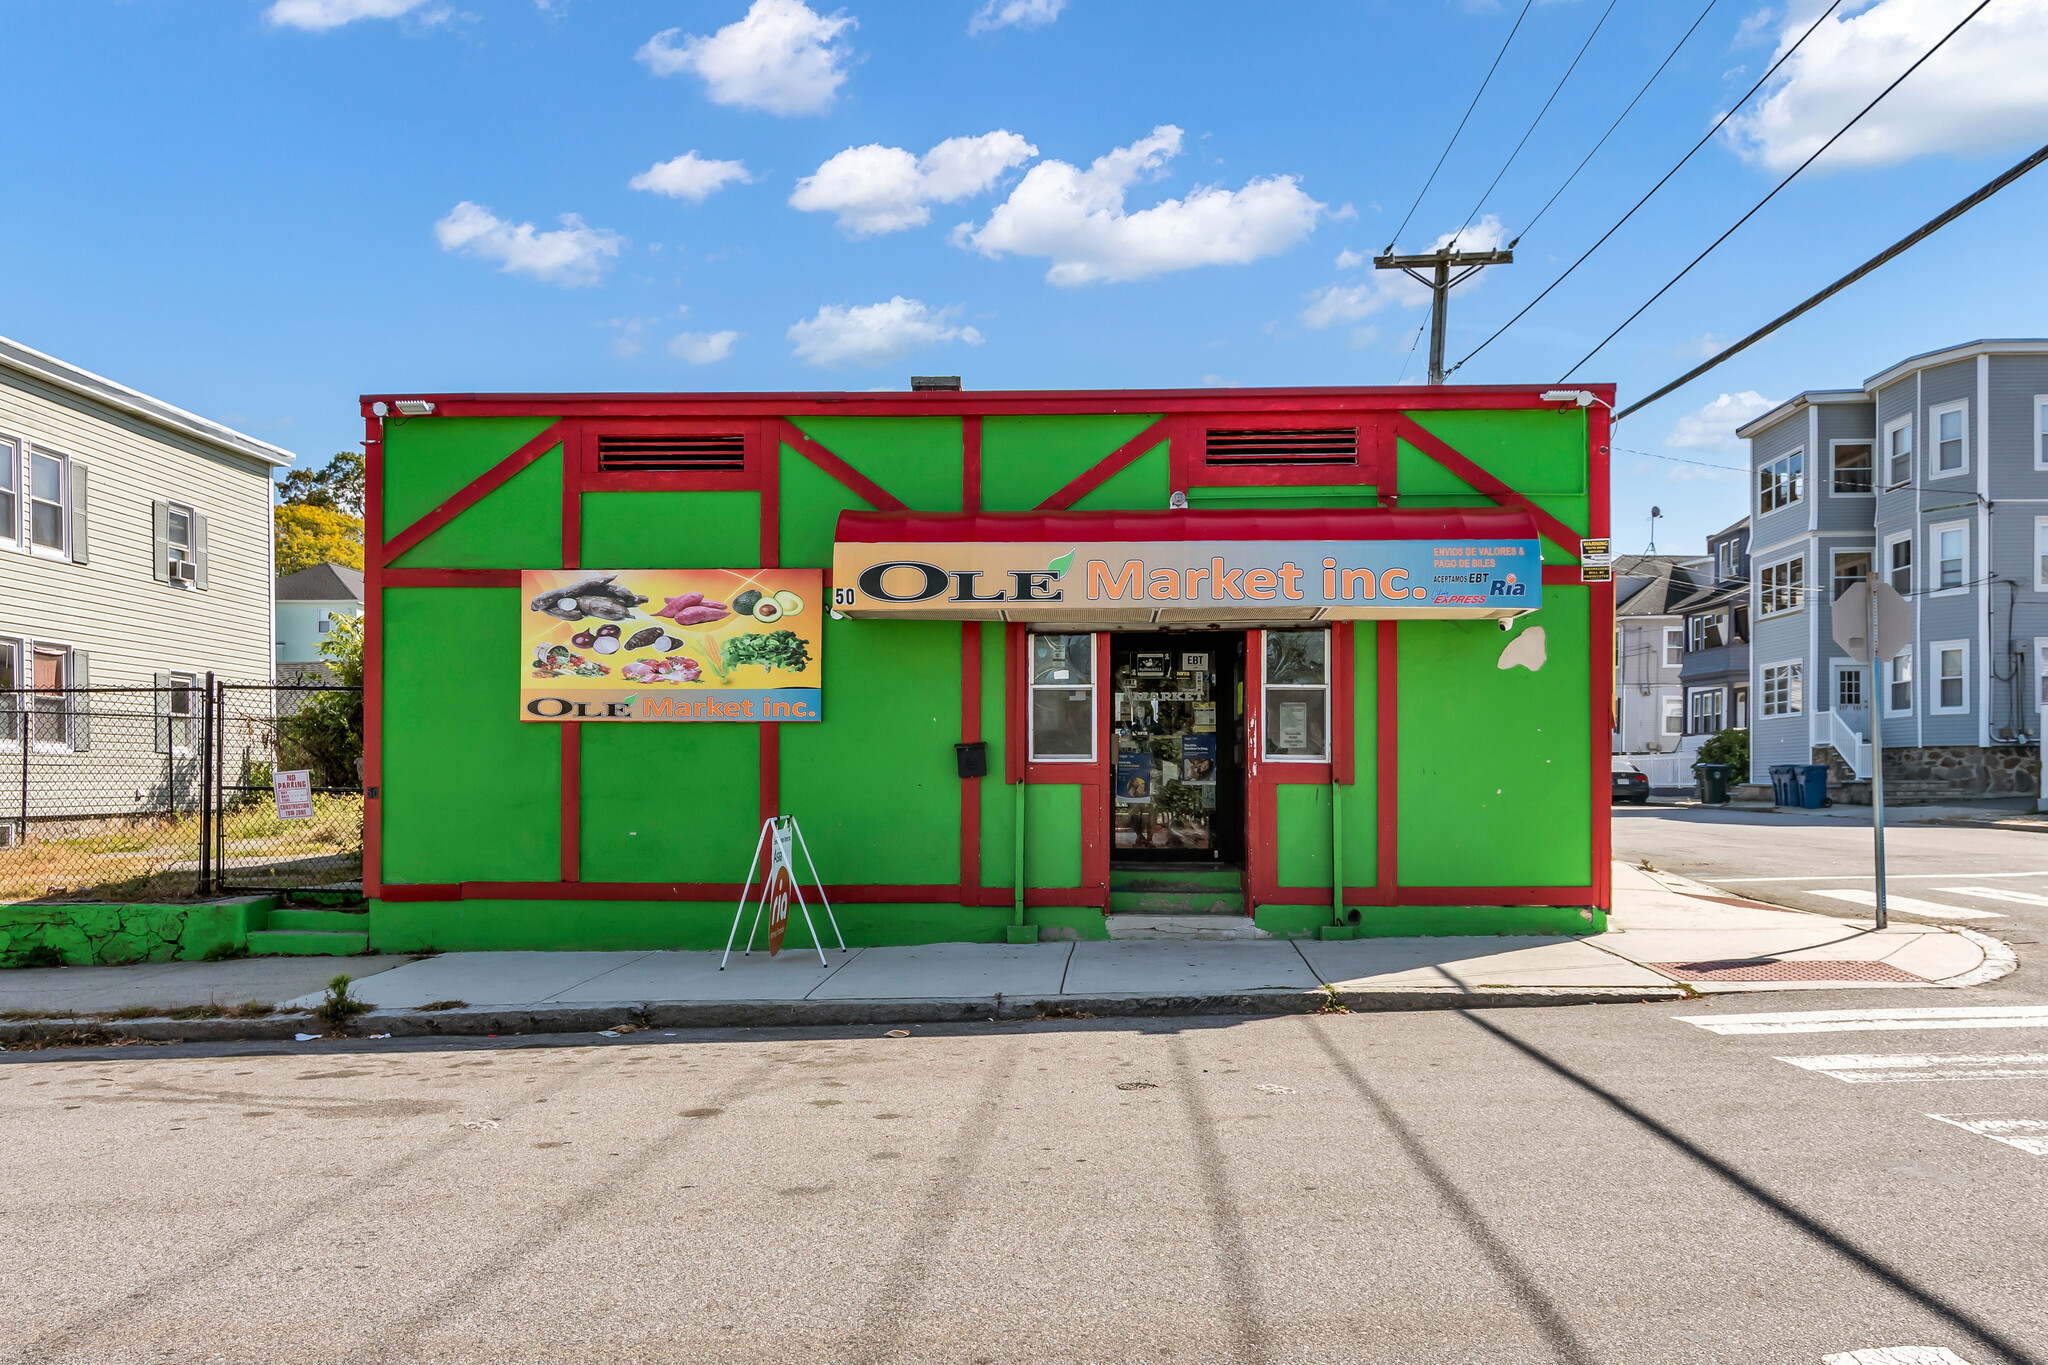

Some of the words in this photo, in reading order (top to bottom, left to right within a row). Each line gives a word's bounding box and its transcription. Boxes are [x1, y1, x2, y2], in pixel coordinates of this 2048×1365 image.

[1433, 547, 1464, 557] ENVIOS
[1465, 547, 1477, 556] DE
[1478, 547, 1517, 556] VALORES
[1518, 546, 1525, 556] &
[1433, 559, 1457, 568] PAGO
[1458, 559, 1471, 568] DE
[1471, 559, 1496, 568] BILES
[1086, 557, 1304, 600] Market
[1322, 557, 1428, 600] inc.
[1468, 573, 1489, 583] EBT
[1489, 573, 1526, 596] Ria
[836, 588, 855, 605] 50
[1433, 595, 1487, 604] EXPRESS
[1187, 656, 1204, 664] EBT
[1132, 692, 1204, 701] MARKET
[643, 697, 754, 717] Market
[763, 697, 816, 717] inc.
[278, 781, 306, 789] PARKING
[772, 879, 788, 926] ria
